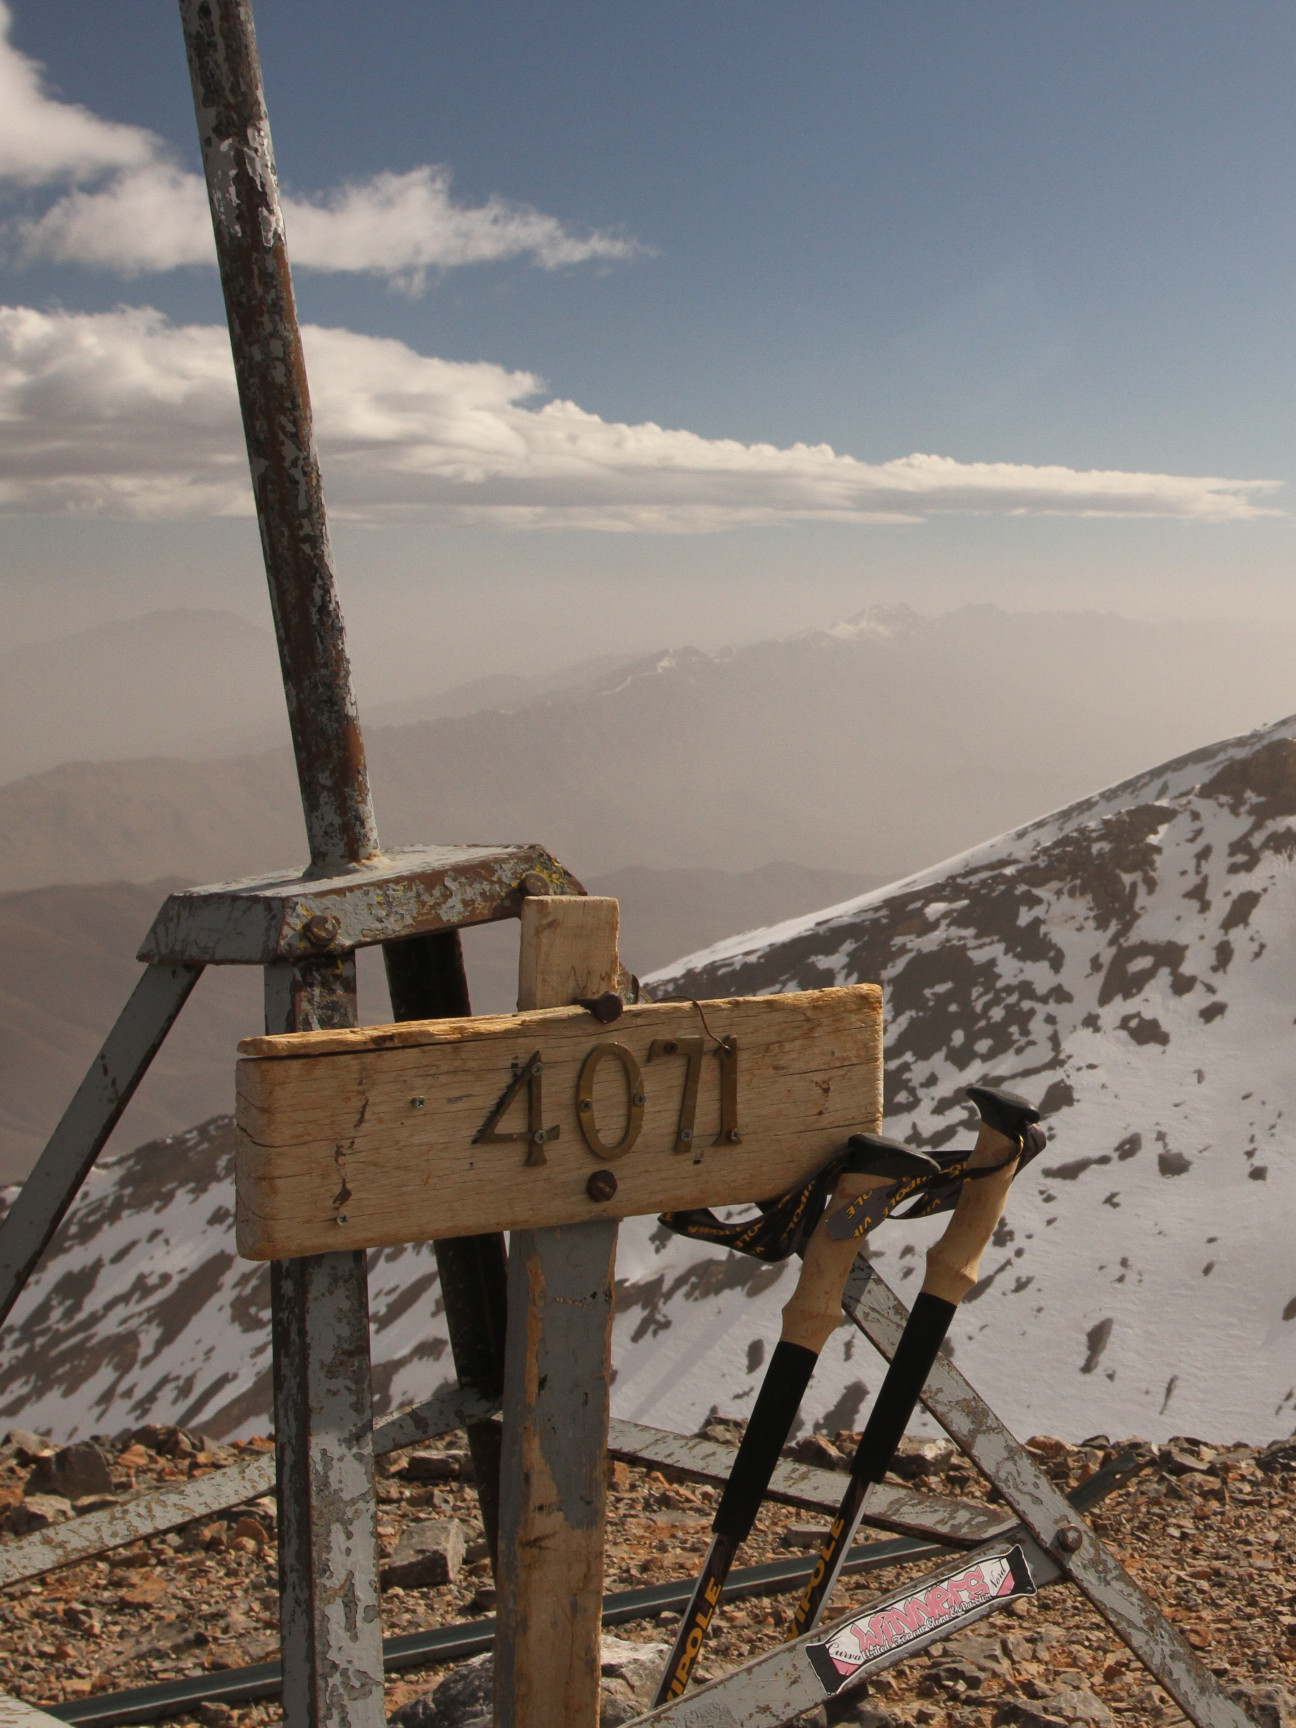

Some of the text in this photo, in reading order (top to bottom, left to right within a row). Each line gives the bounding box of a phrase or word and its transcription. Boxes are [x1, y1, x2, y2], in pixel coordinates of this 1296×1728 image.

[471, 1034, 743, 1167] 4071
[785, 1516, 845, 1642] VIPOLE
[828, 1641, 861, 1661] Curva
